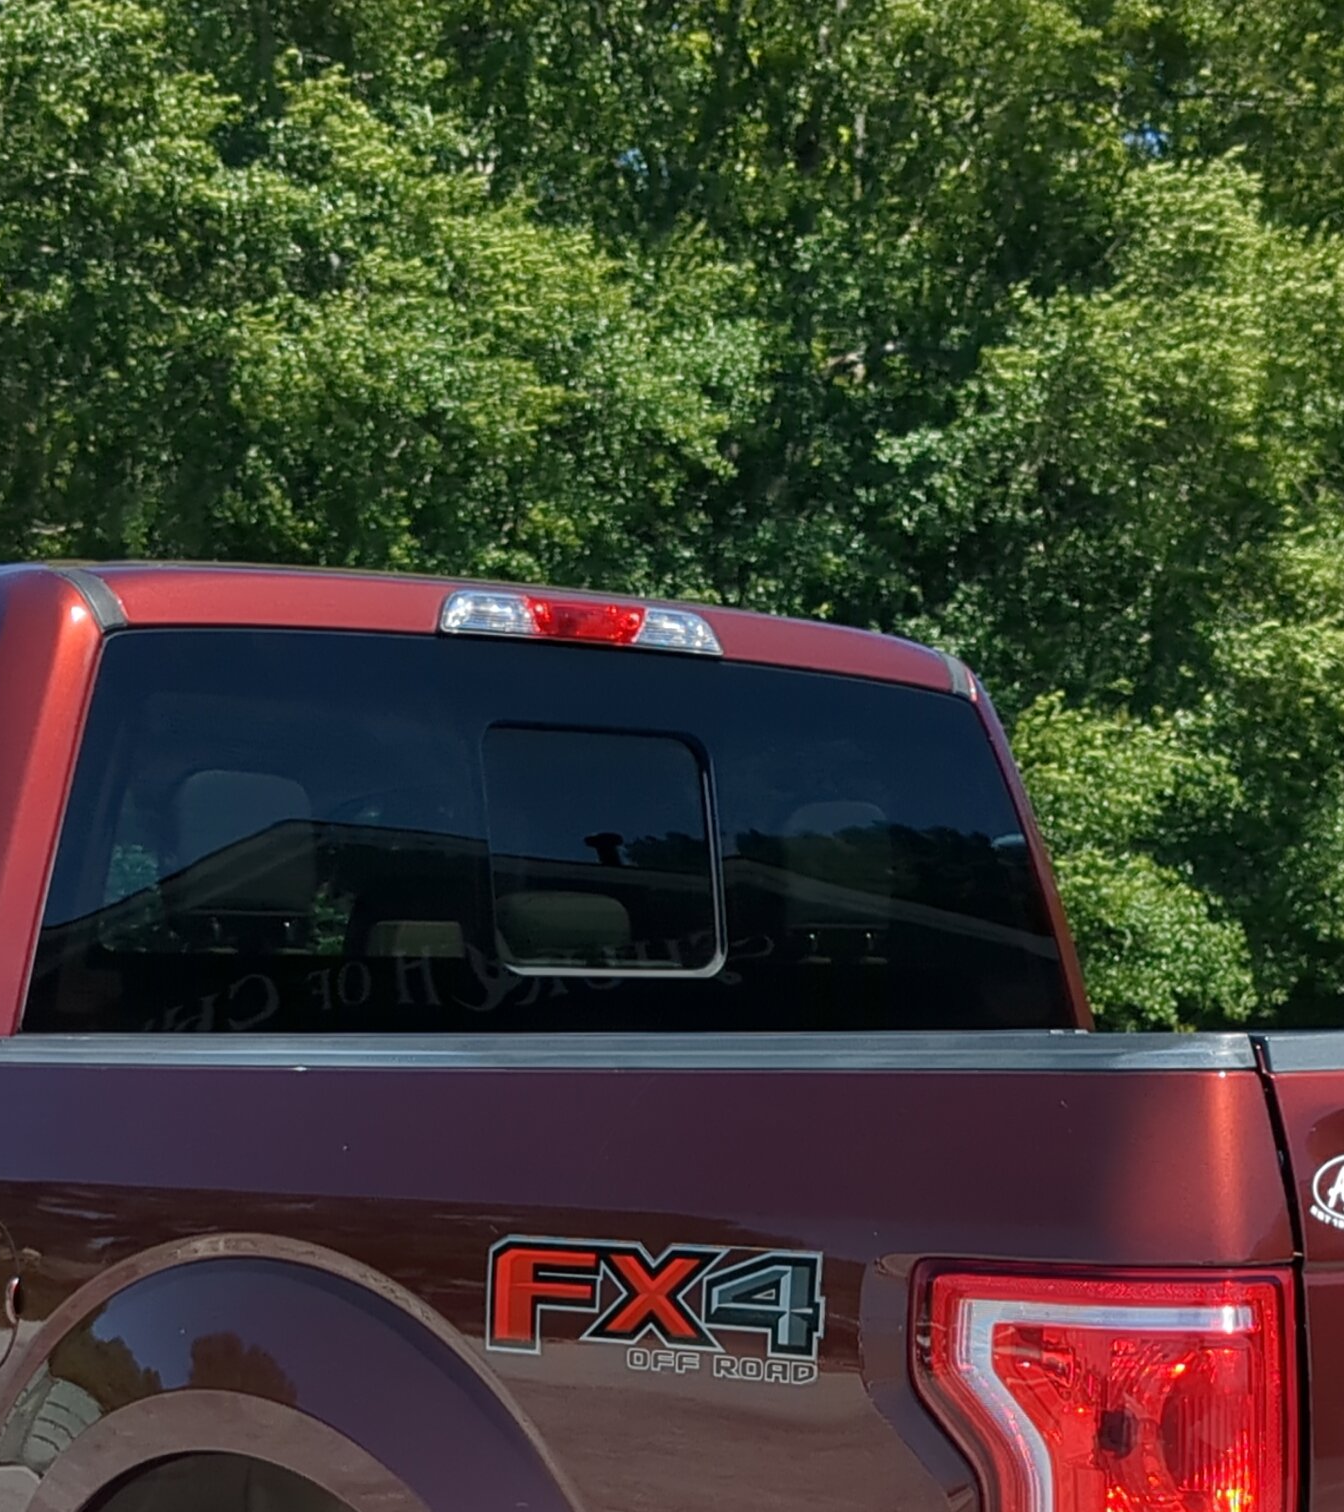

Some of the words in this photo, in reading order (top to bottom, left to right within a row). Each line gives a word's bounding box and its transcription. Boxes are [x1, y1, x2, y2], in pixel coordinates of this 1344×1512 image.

[486, 1234, 825, 1361] FX4
[626, 1347, 701, 1375] OFF
[712, 1354, 819, 1385] ROAD
